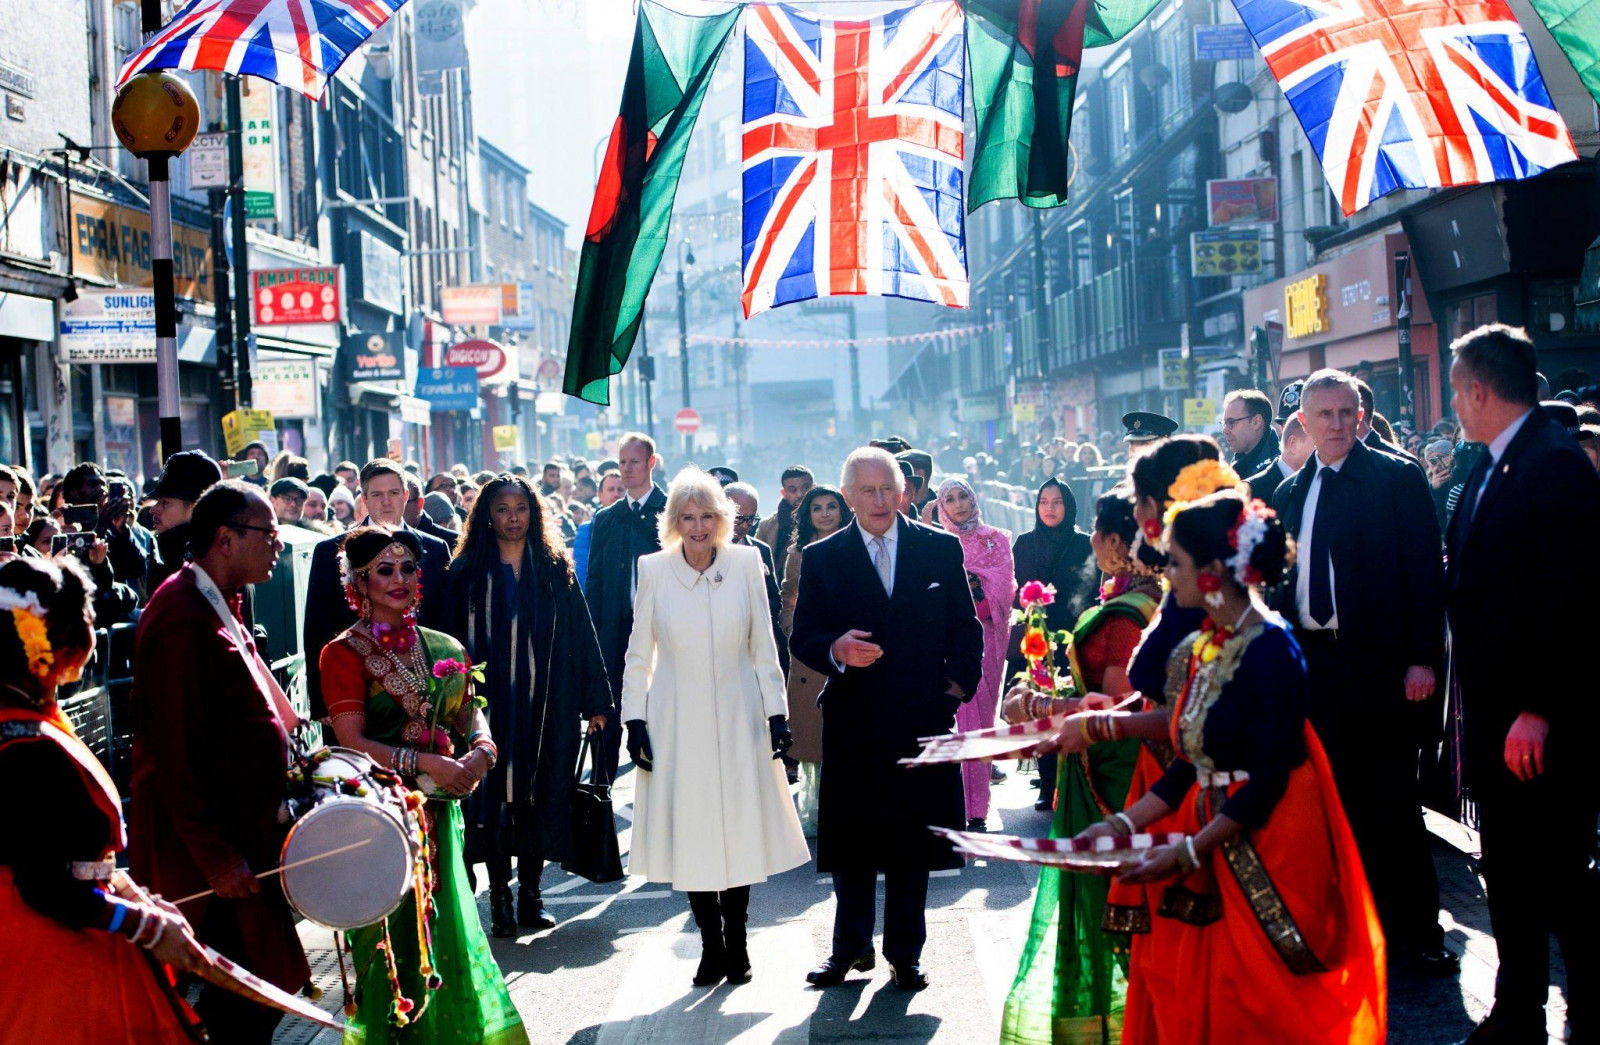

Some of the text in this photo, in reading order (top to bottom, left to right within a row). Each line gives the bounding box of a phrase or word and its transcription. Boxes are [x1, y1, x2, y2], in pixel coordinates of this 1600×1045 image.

[192, 135, 224, 147] CCTV
[258, 269, 336, 288] AMAR GAON
[104, 296, 156, 309] SUNLIGH
